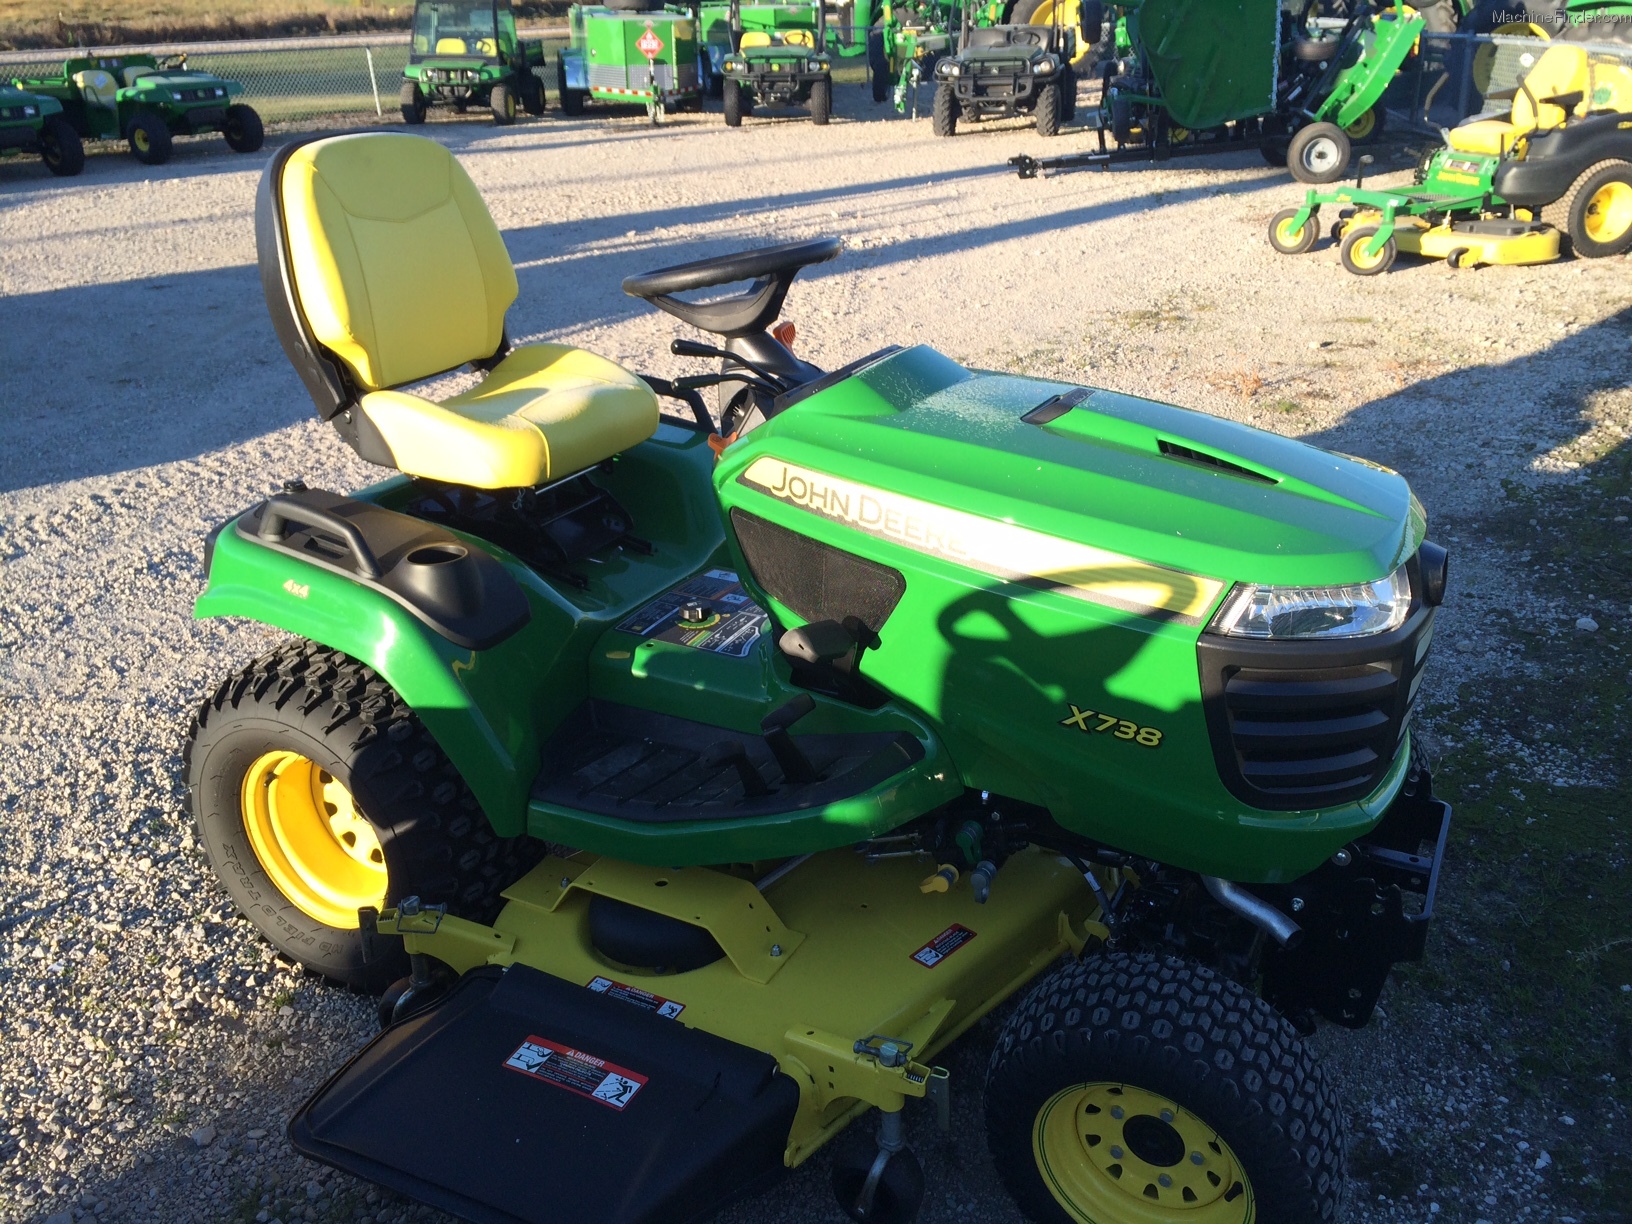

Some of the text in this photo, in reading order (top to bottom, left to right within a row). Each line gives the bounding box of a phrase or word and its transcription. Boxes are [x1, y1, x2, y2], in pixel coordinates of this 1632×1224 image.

[772, 467, 967, 555] JOHN DEERE
[1060, 704, 1163, 747] X738
[222, 843, 262, 901] TRAX
[262, 905, 316, 946] FIELD
[574, 1051, 606, 1068] DANGER
